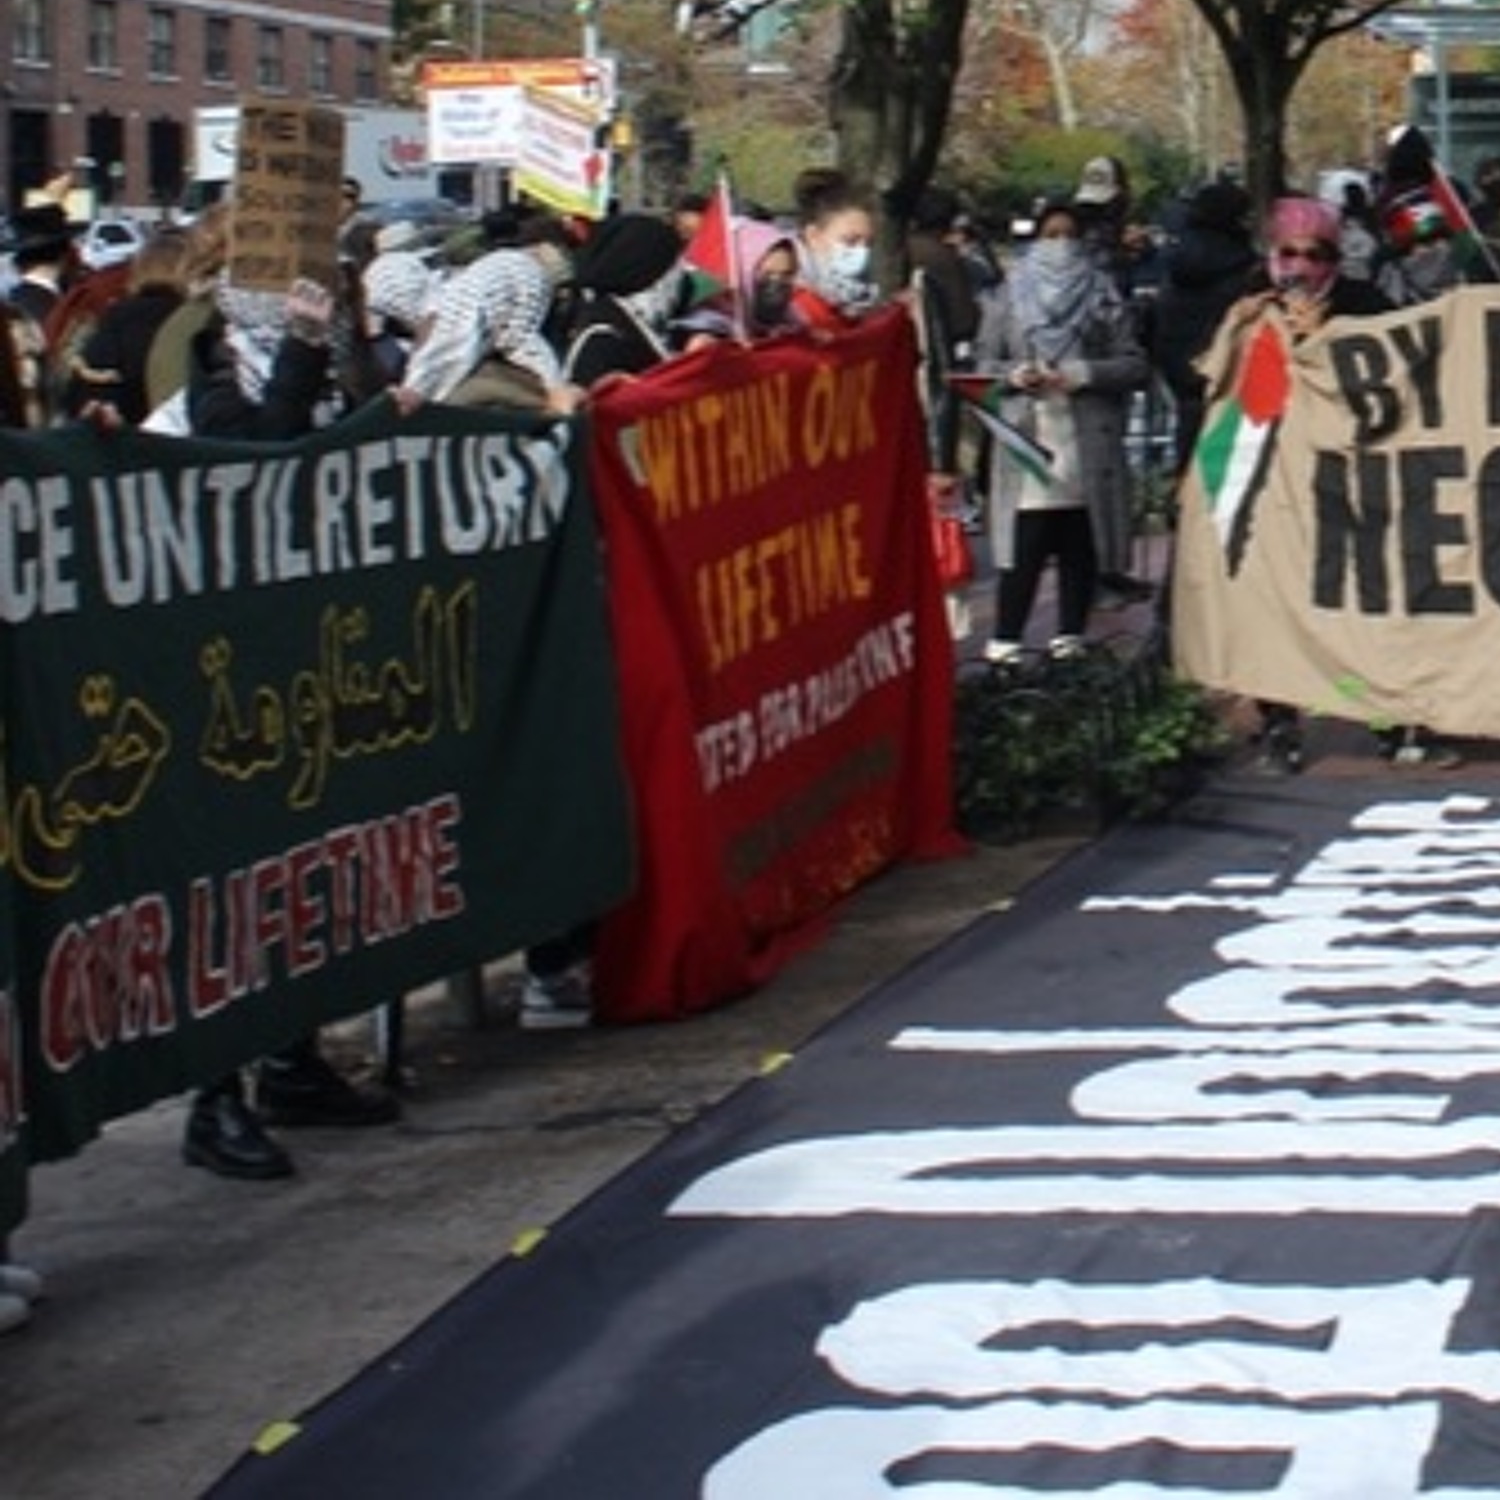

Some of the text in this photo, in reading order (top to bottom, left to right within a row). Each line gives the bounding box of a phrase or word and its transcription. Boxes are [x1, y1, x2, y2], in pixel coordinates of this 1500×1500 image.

[640, 369, 793, 525] WITHIN
[1329, 315, 1443, 445] BY
[697, 500, 873, 674] LIFETIME
[40, 892, 177, 1073] OUR
[188, 792, 465, 1020] LIFETIME
